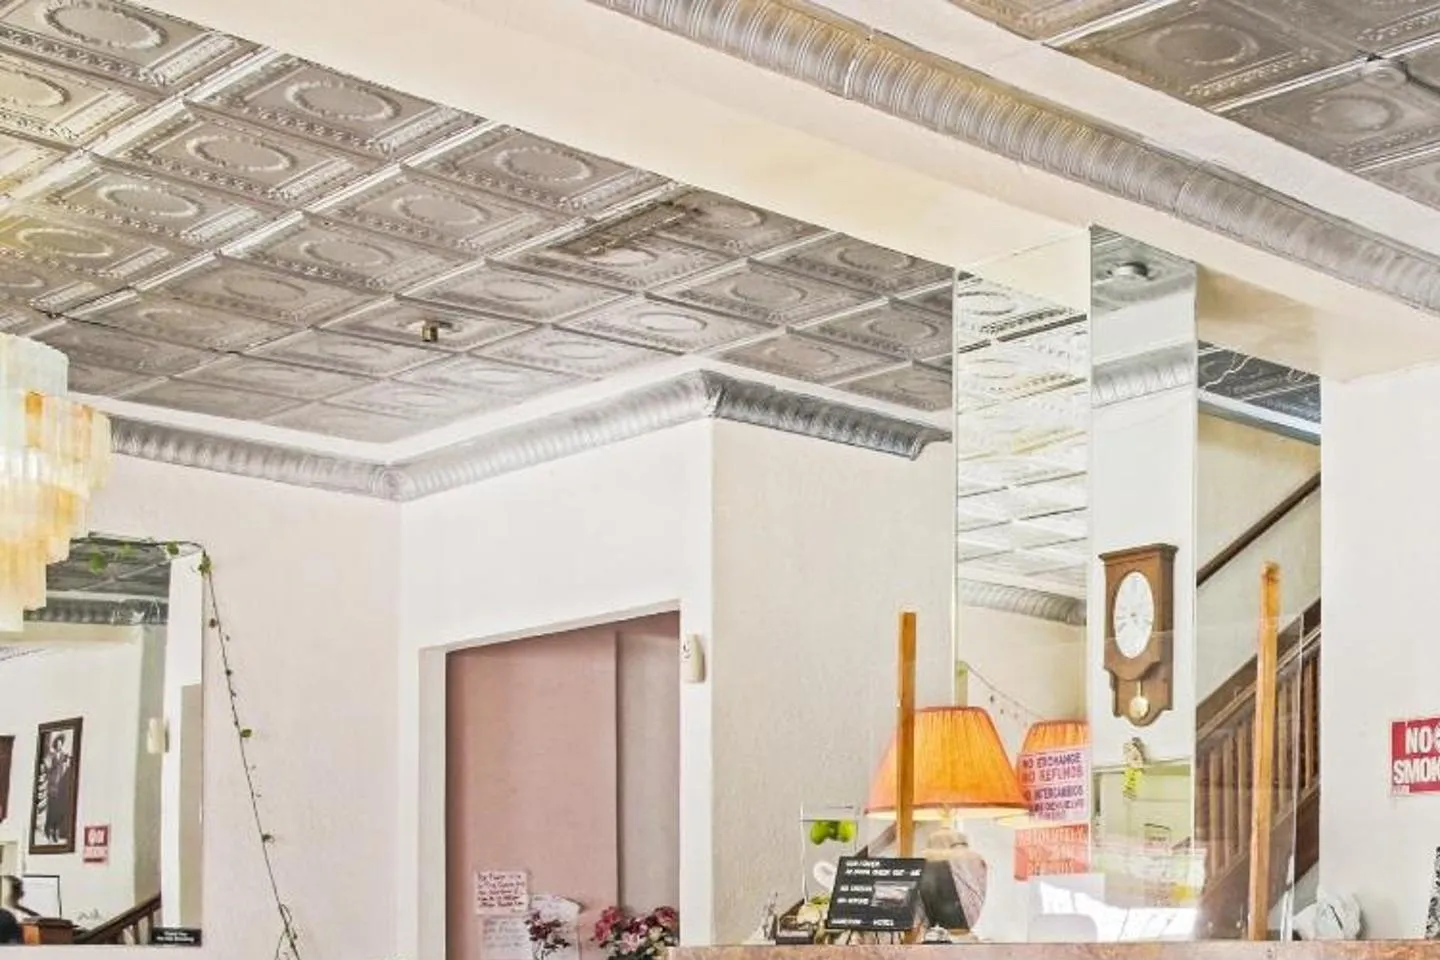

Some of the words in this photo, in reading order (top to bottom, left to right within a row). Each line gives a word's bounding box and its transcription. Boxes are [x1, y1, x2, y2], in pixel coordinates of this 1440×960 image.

[1405, 725, 1432, 754] NO
[1036, 752, 1081, 768] EXCHANGE
[1039, 765, 1084, 781] REFUNDS
